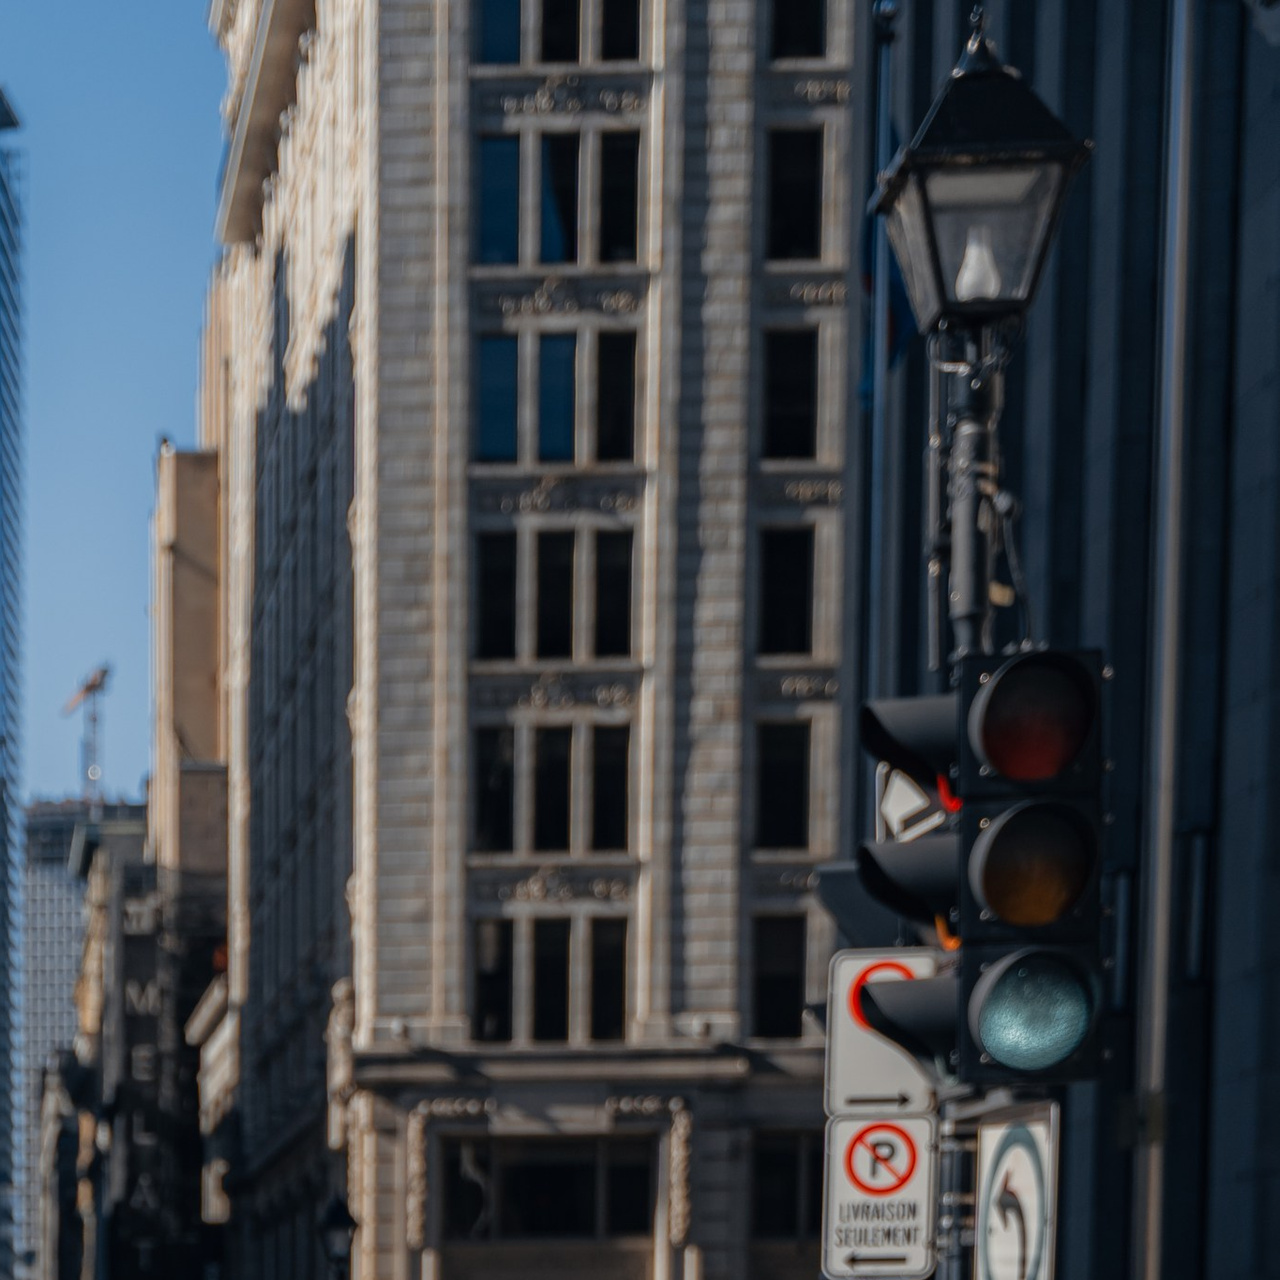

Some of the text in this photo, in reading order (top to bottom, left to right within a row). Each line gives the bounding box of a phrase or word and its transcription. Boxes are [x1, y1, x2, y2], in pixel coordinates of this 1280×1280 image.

[870, 1141, 895, 1179] P
[839, 1202, 918, 1223] LIVRAISON
[834, 1225, 920, 1248] SEULEMENT
